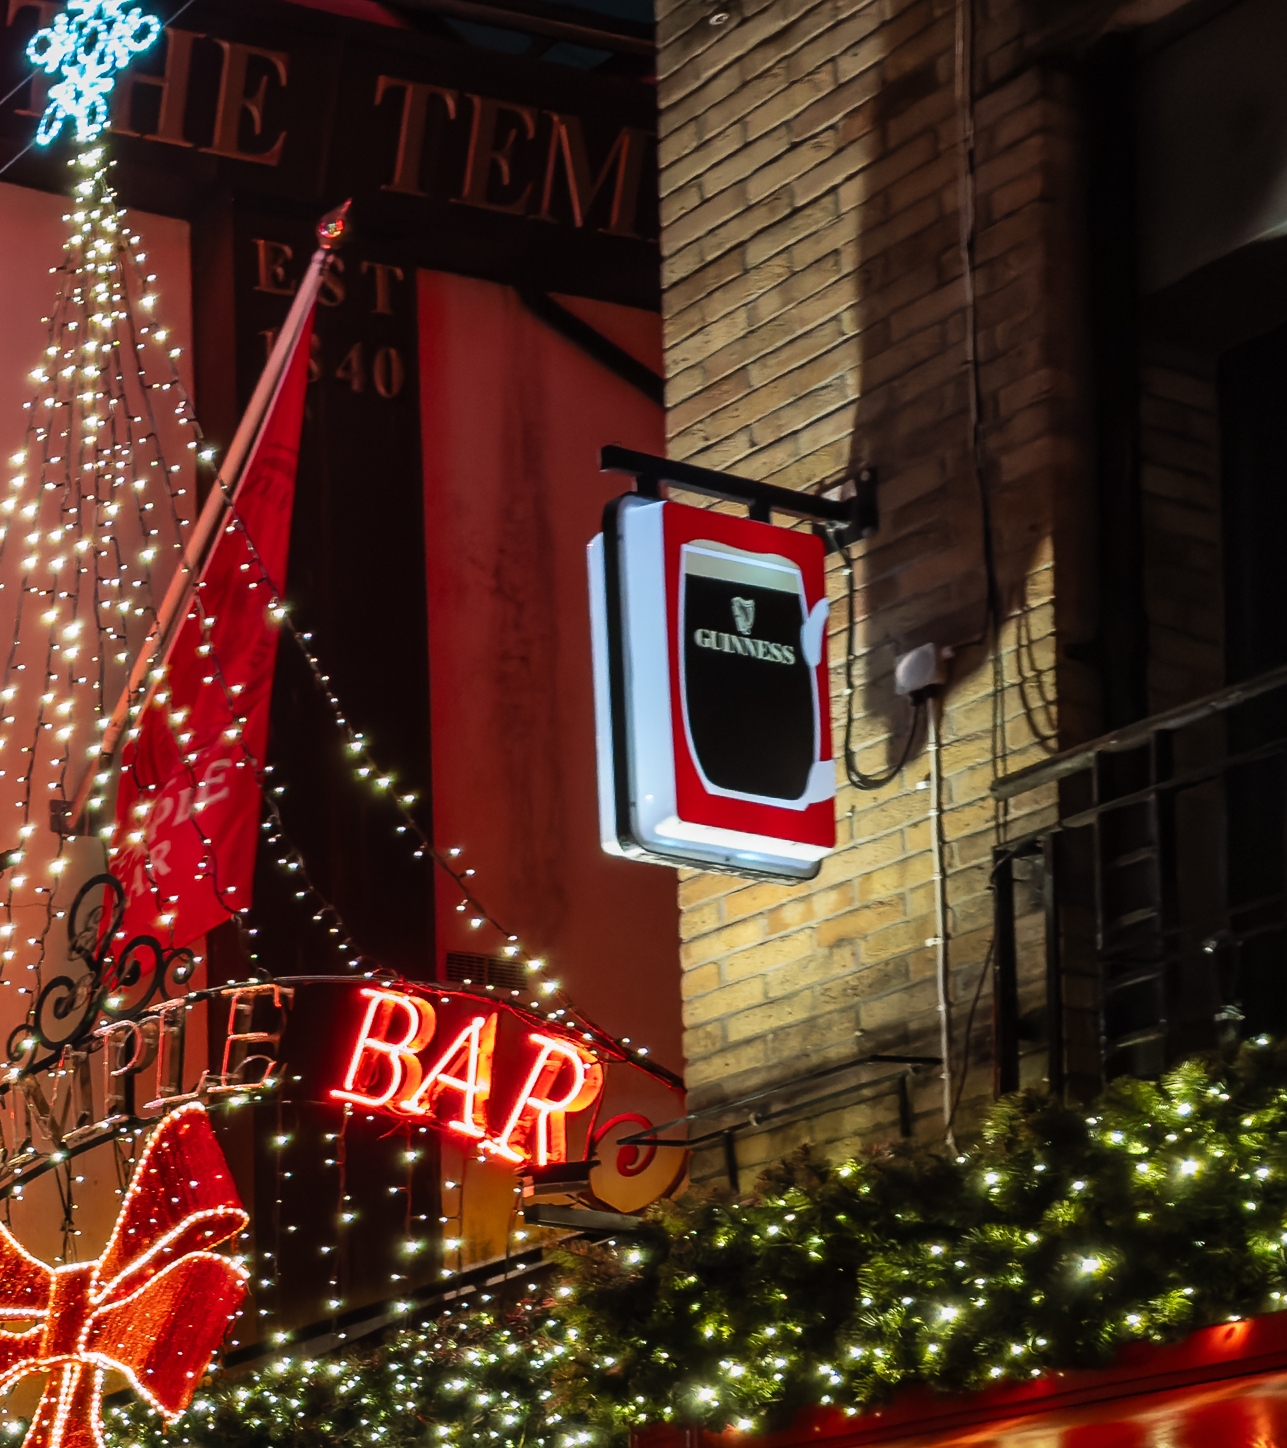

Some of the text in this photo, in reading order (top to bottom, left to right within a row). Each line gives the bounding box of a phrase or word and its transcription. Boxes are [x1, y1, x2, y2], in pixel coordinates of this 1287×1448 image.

[7, 2, 290, 167] HE
[252, 238, 405, 316] EST
[693, 628, 797, 666] GUINNESS
[329, 986, 604, 1166] BAR
